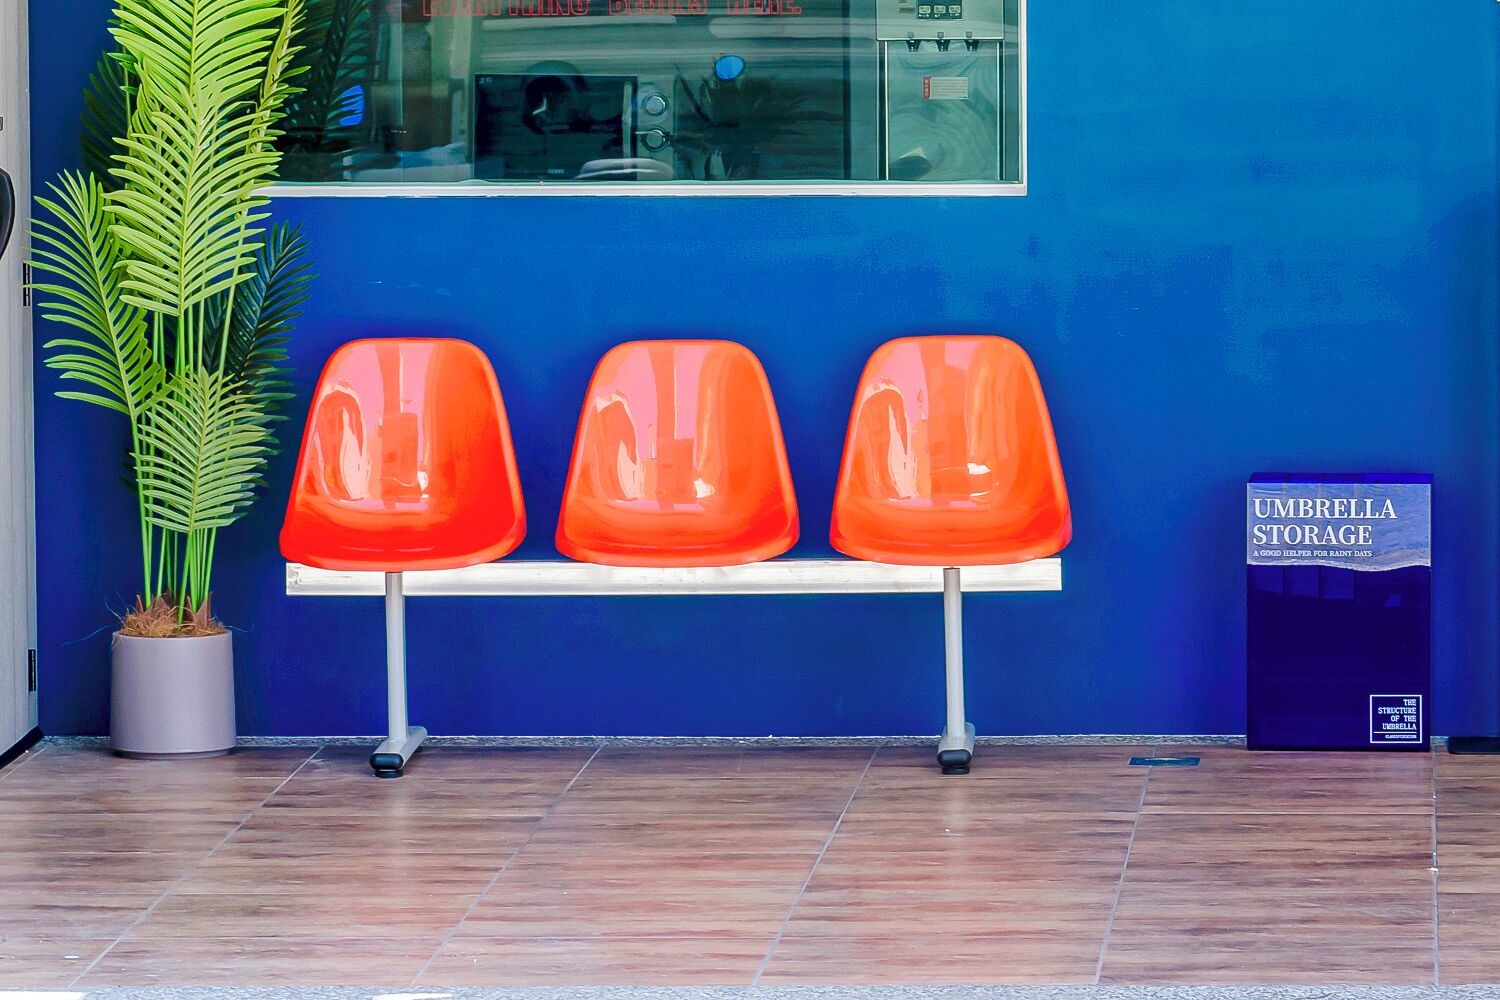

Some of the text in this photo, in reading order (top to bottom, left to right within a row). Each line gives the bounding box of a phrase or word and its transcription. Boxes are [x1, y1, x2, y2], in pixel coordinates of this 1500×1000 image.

[1253, 498, 1397, 519] UMBRELLA
[1253, 524, 1373, 546] STORAGE
[1253, 549, 1373, 558] A GOOD HELPER FOR RAINY DAYS
[1403, 698, 1417, 706] THE
[1378, 706, 1417, 714] STRUCTURE
